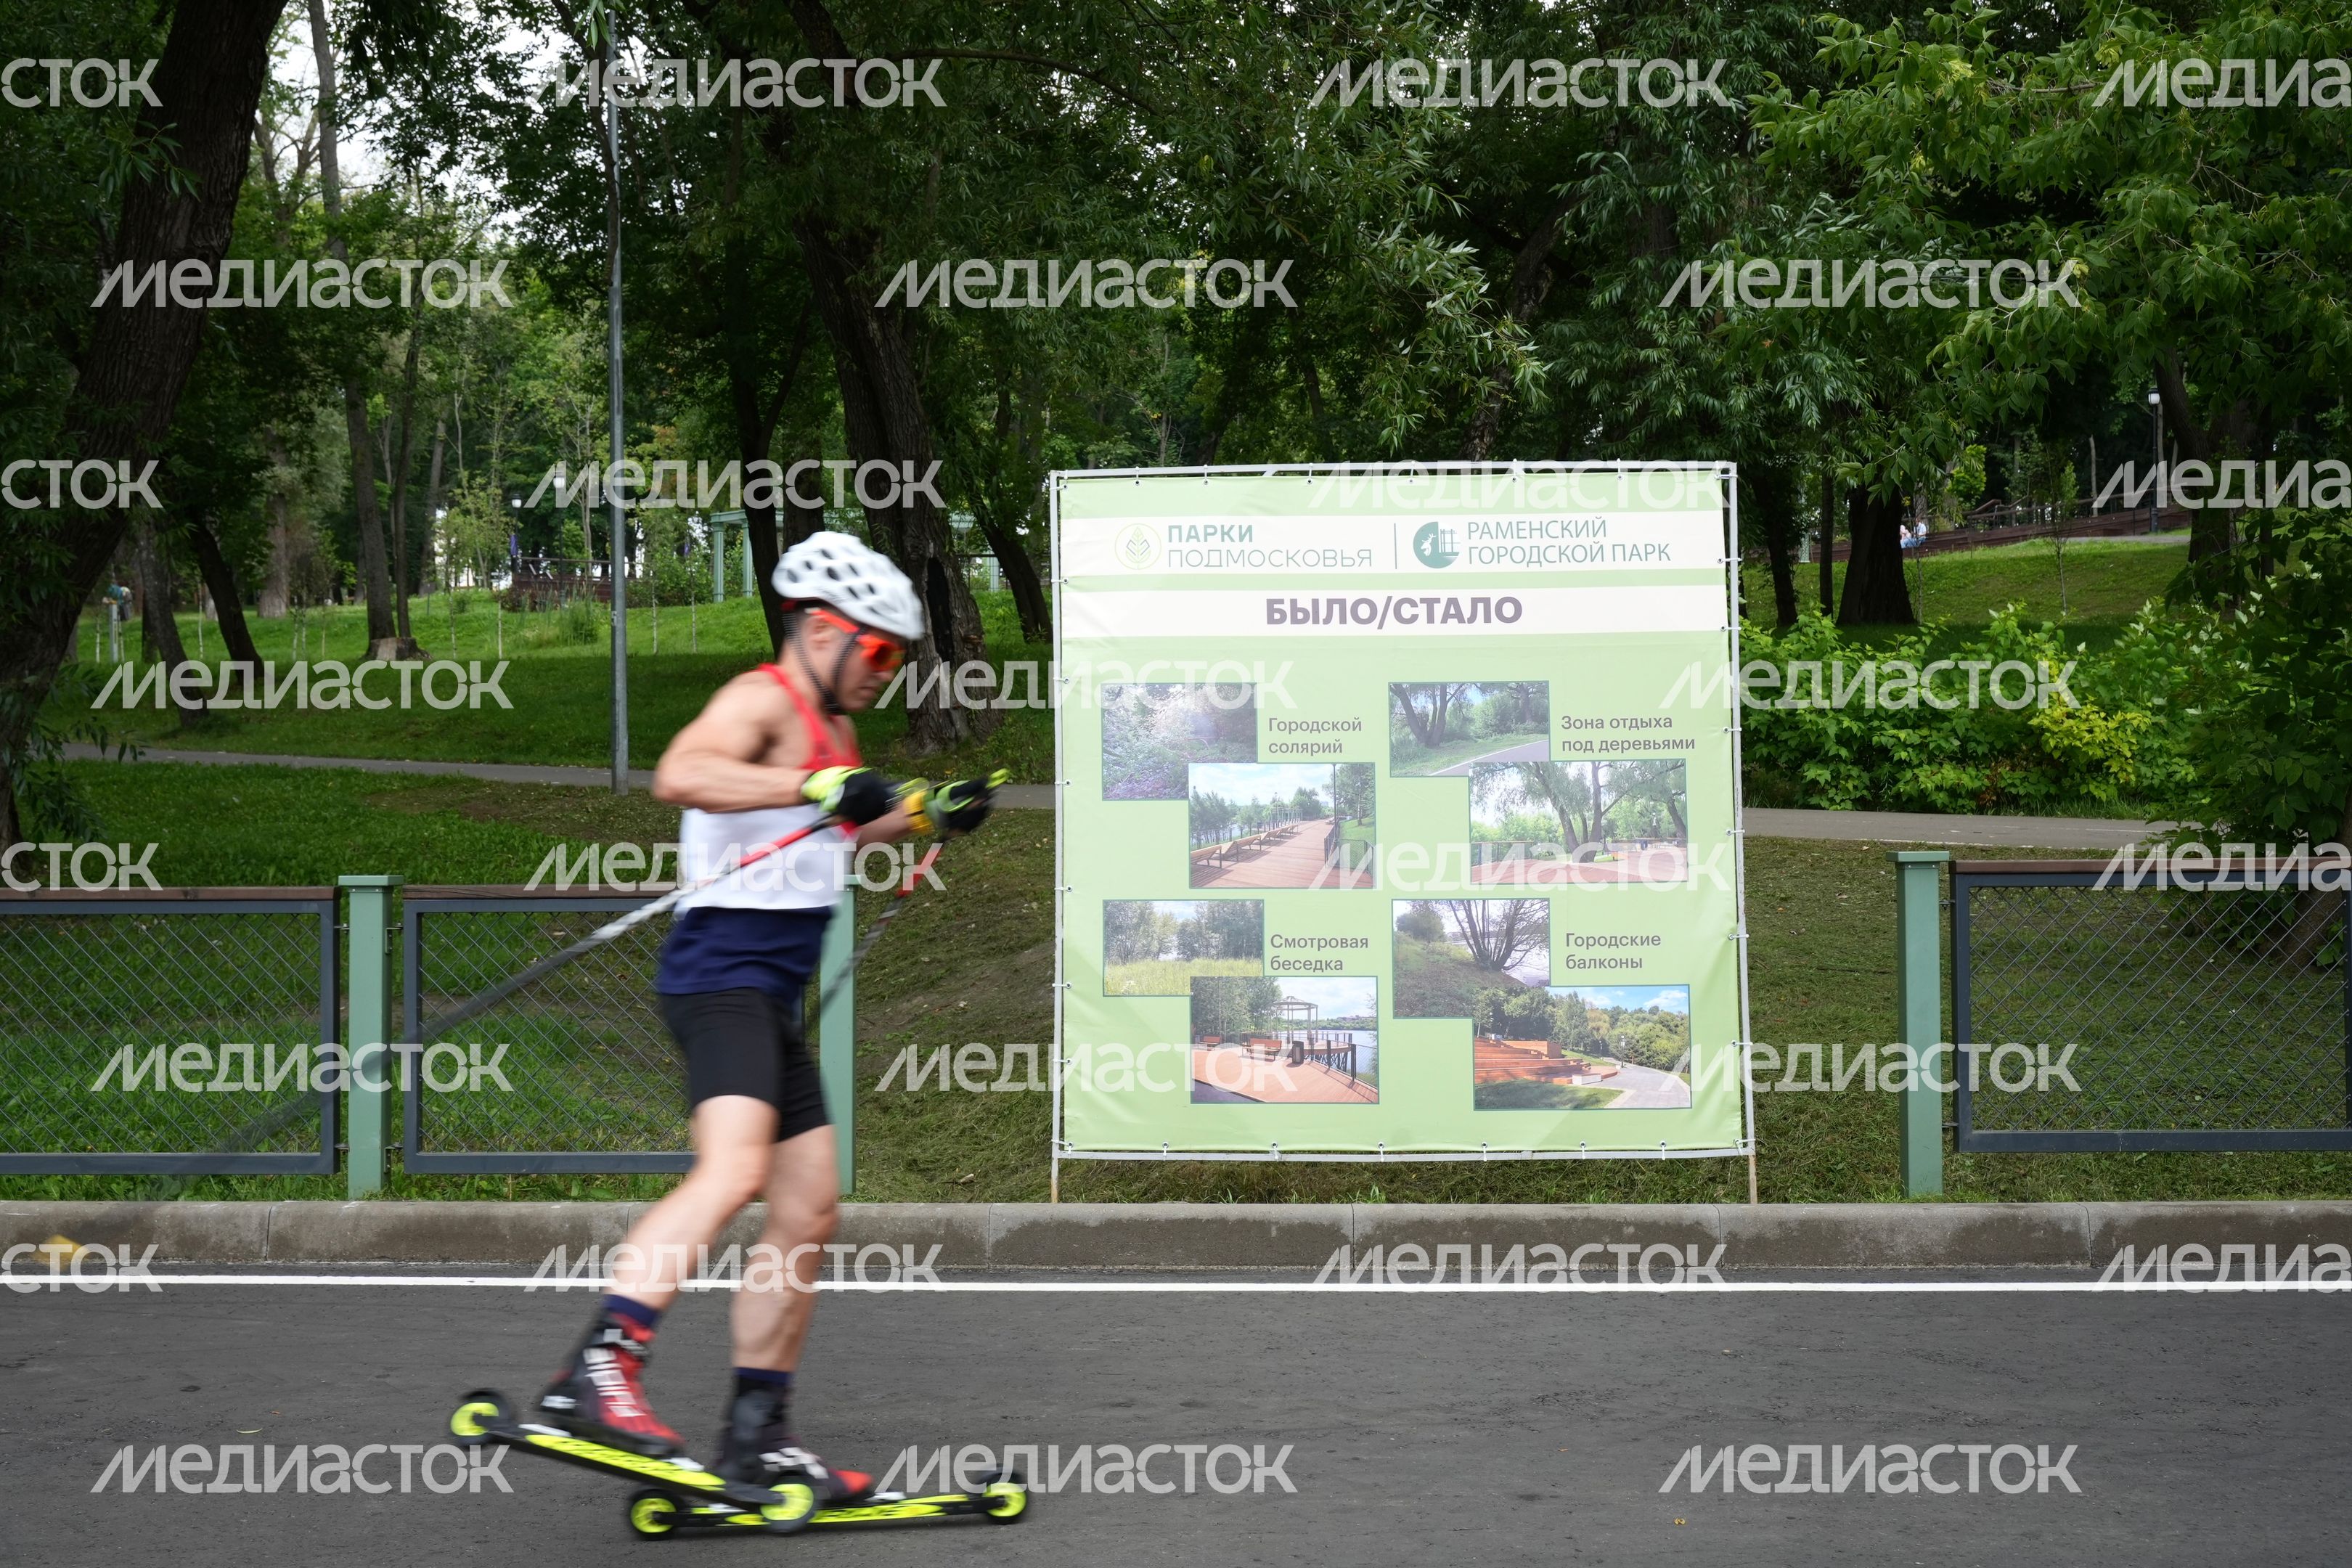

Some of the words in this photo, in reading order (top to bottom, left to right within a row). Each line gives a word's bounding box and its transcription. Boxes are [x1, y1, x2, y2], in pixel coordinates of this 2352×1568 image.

[1167, 524, 1254, 544] ПАРКИ
[1468, 516, 1608, 540] РАМЕНСКИЙ
[1168, 549, 1373, 568] ПОДМОСКОВЬЯ
[1469, 541, 1605, 568] ГОРОДСКОЙ
[1612, 543, 1672, 563] ПАРК
[1265, 595, 1523, 630] БЫЛО/СТАЛО
[1268, 716, 1363, 735] Городской
[1561, 715, 1605, 730] Зона
[1609, 716, 1673, 731] отдыха
[1268, 738, 1343, 756] солярий
[1561, 739, 1595, 754] под
[1598, 738, 1696, 754] деревьями
[1270, 934, 1369, 952] Смотровая
[1566, 932, 1662, 950] Городские
[1270, 955, 1344, 973] беседка
[1566, 954, 1643, 970] балконы
